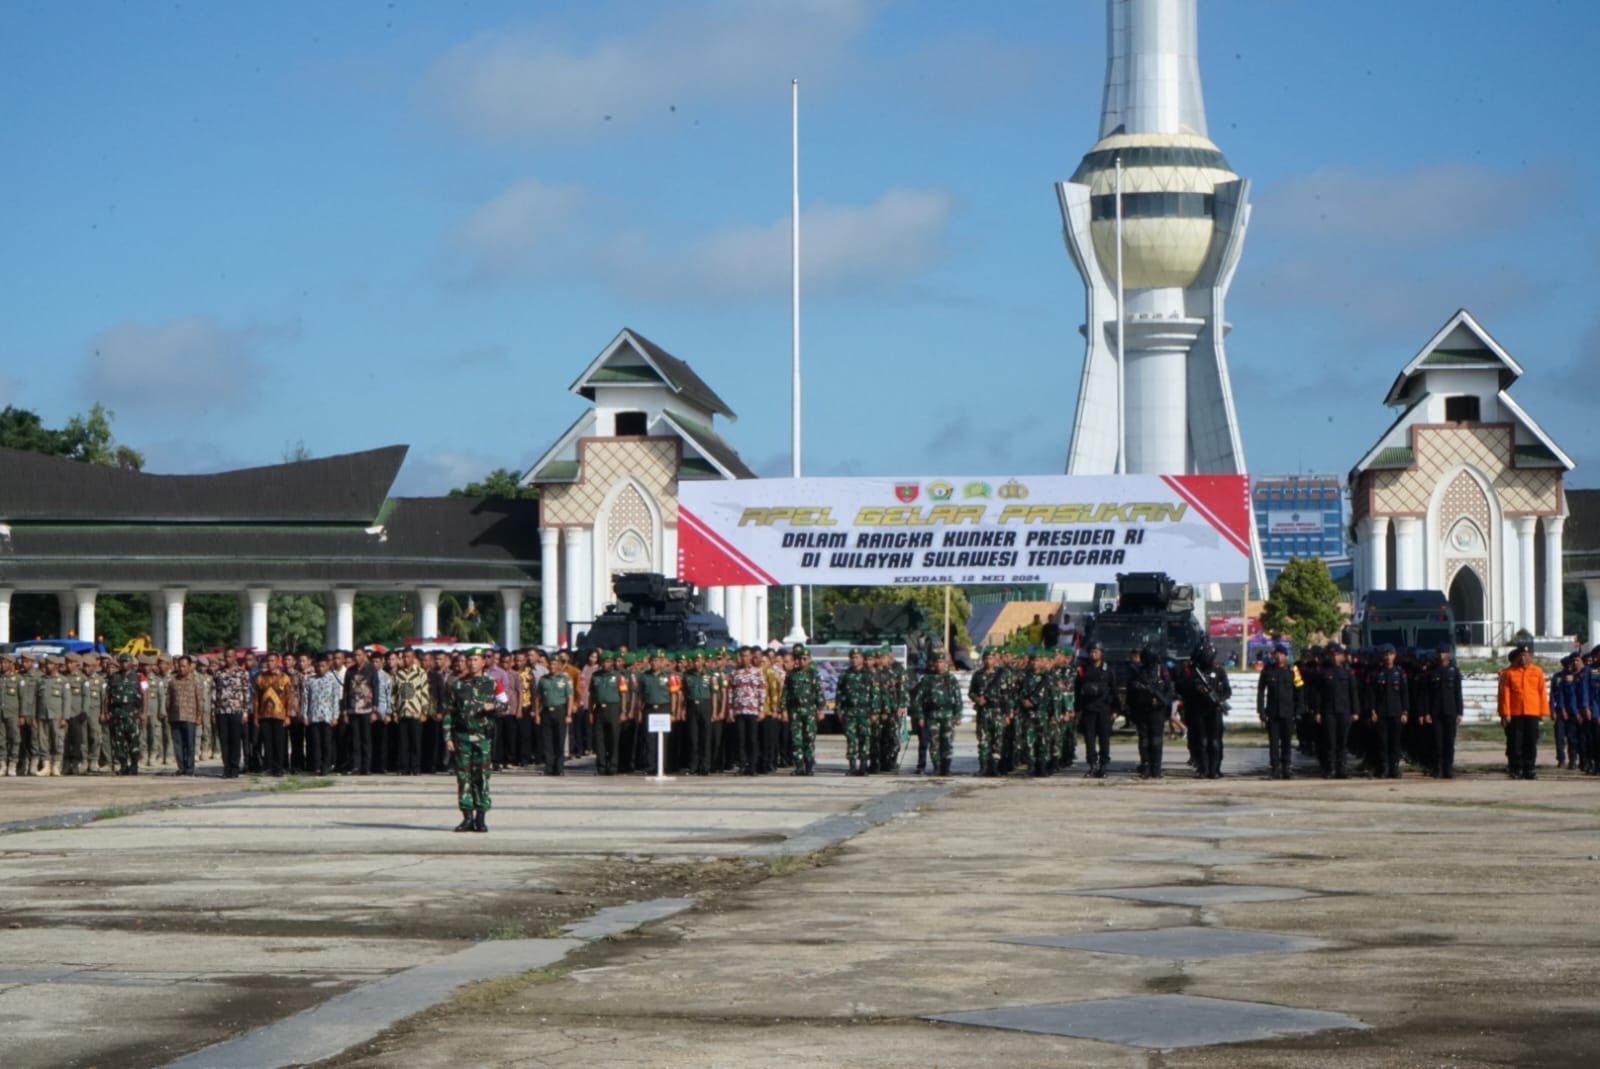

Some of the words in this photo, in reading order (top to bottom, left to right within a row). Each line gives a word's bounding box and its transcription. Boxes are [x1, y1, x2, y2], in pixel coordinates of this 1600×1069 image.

[737, 506, 839, 527] APEL
[853, 505, 986, 526] GELAR
[997, 502, 1189, 525] PASUKAN
[781, 532, 848, 548] DALAM
[856, 532, 934, 548] RANGKA
[942, 531, 1017, 548] KUNKER
[1025, 529, 1116, 547] PRESIDEN
[1124, 528, 1145, 545] RI
[800, 552, 821, 568] DI
[829, 552, 914, 569] WILAYAH
[922, 551, 1018, 567] SULAWESI
[1027, 549, 1126, 567] TENGGARA
[981, 574, 1006, 582] MEI
[1012, 574, 1041, 582] 2024
